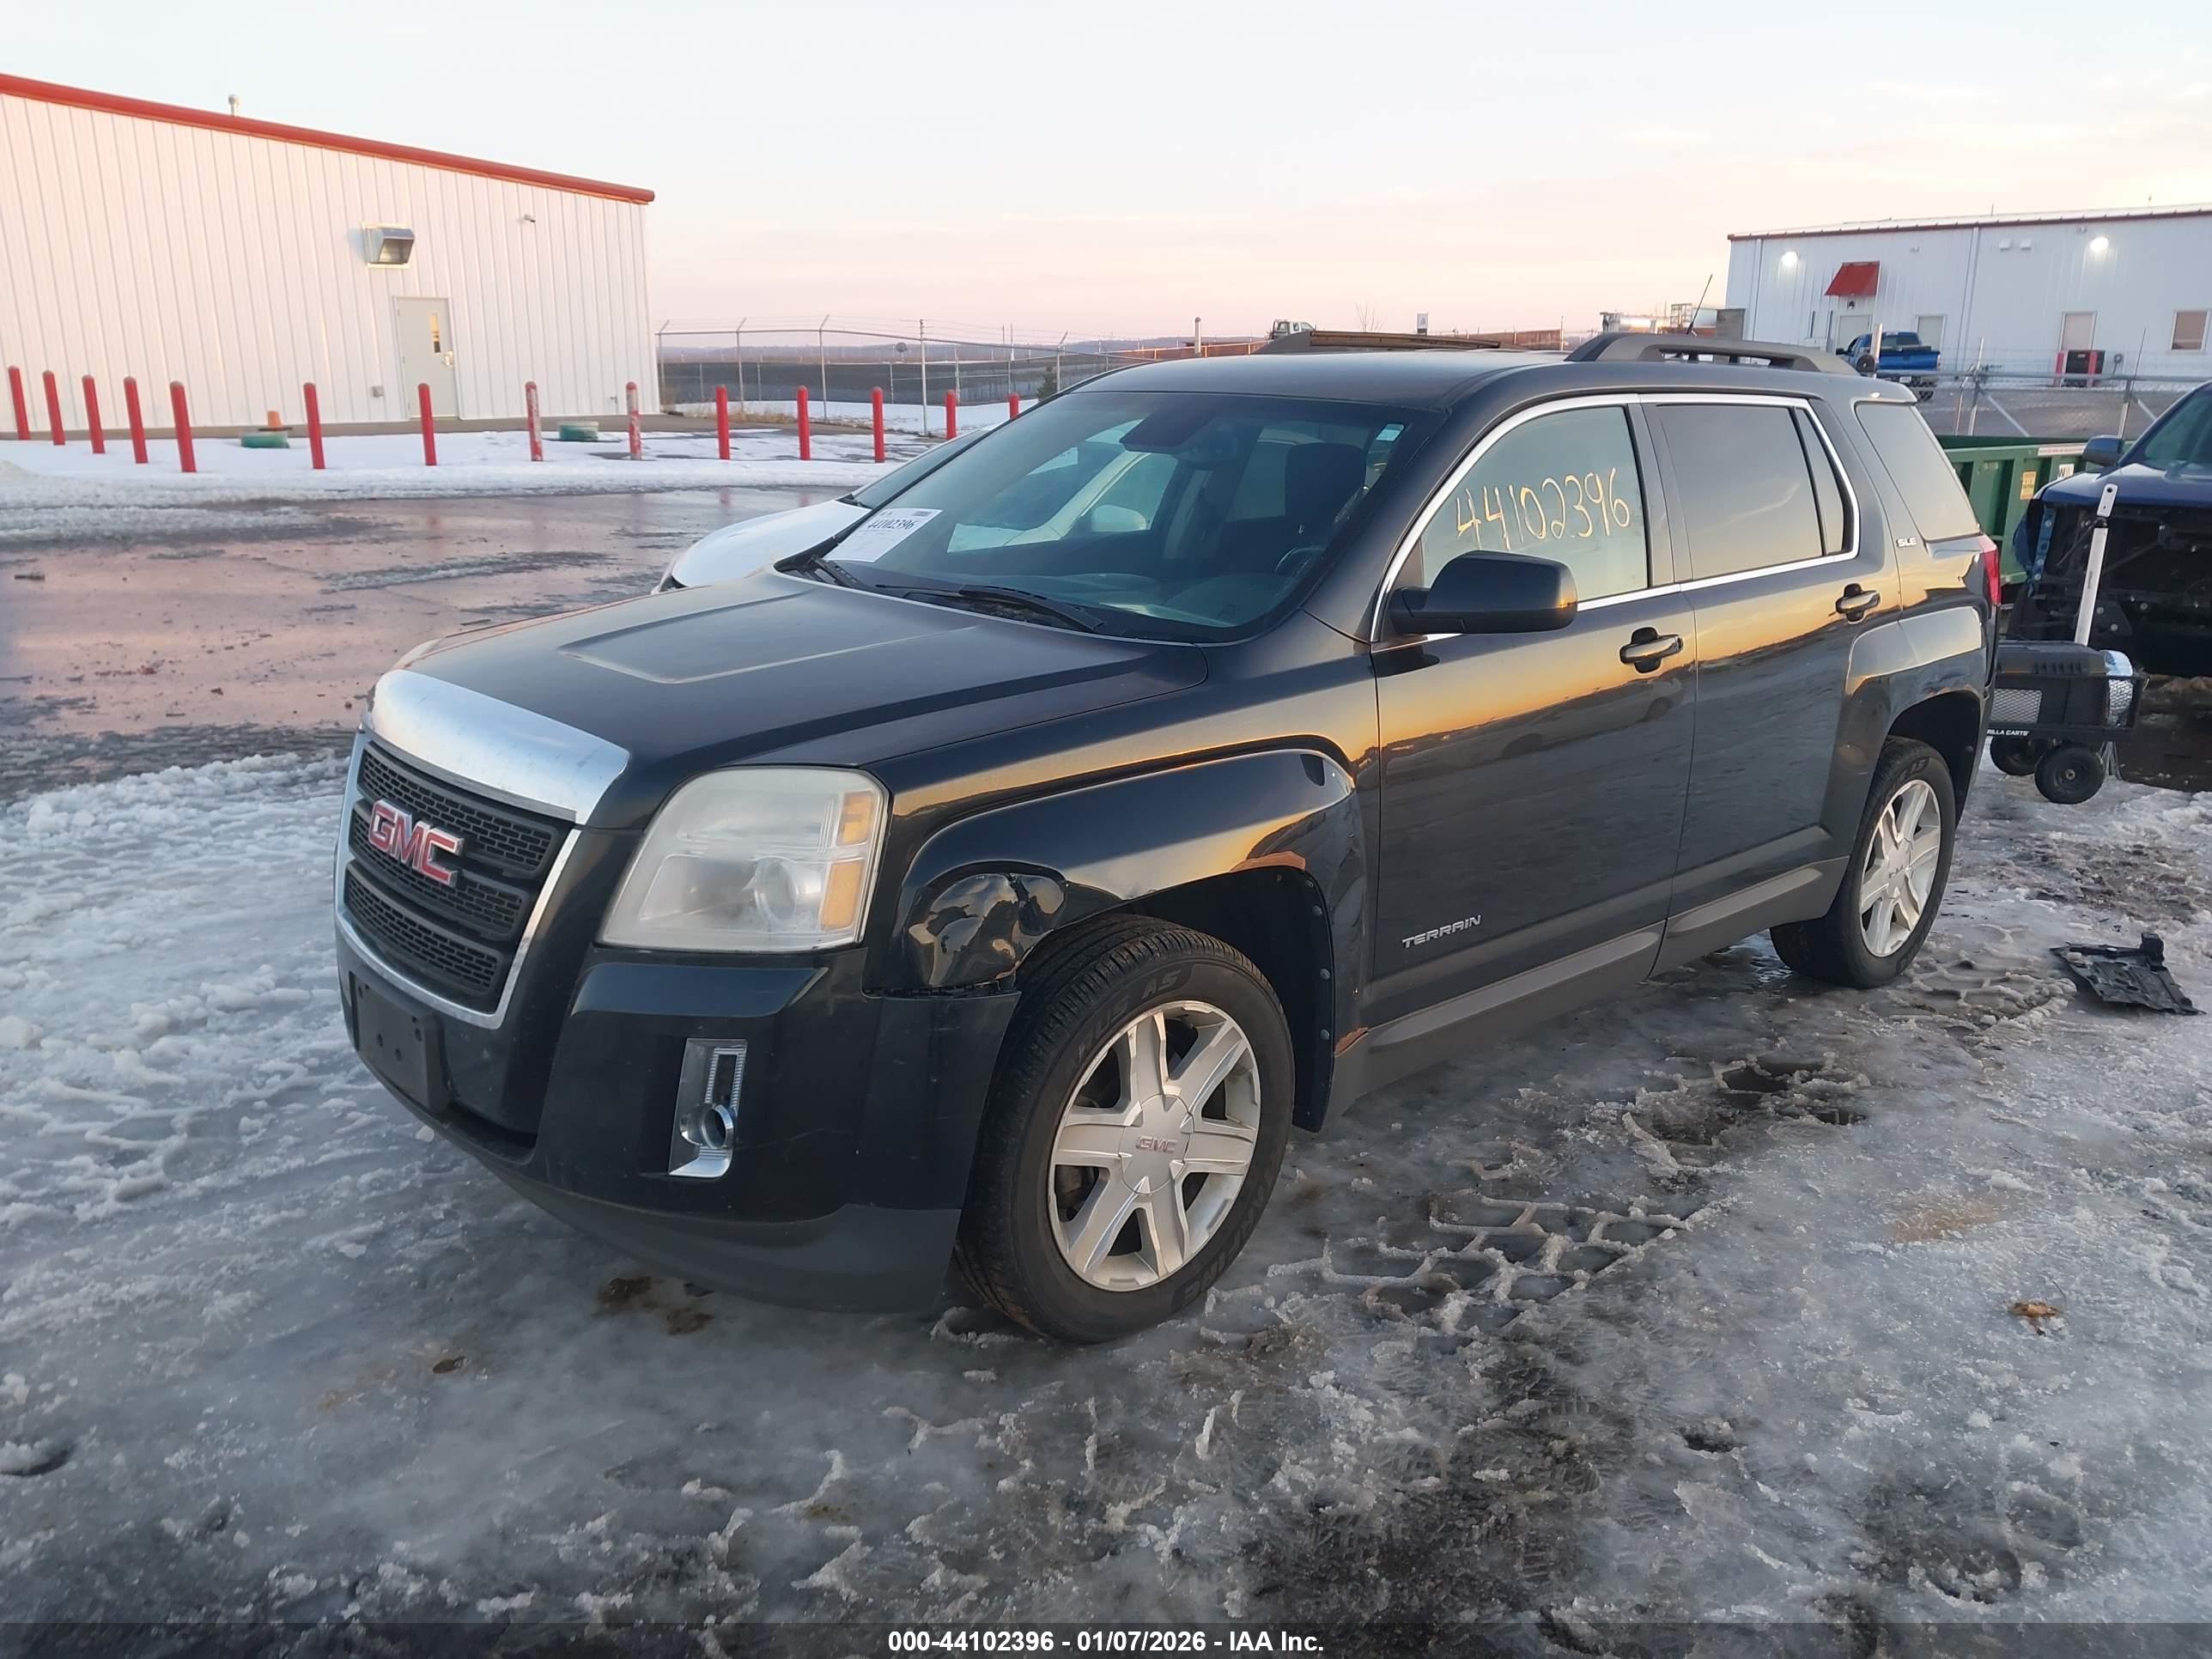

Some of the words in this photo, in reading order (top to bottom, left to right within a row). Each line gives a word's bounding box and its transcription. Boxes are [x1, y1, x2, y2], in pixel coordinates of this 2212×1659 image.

[1455, 467, 1630, 550] 44102396
[1896, 537, 1917, 548] SLE
[368, 799, 465, 888] GMC
[1401, 915, 1482, 949] TERRAIN
[1135, 1134, 1178, 1154] GMC
